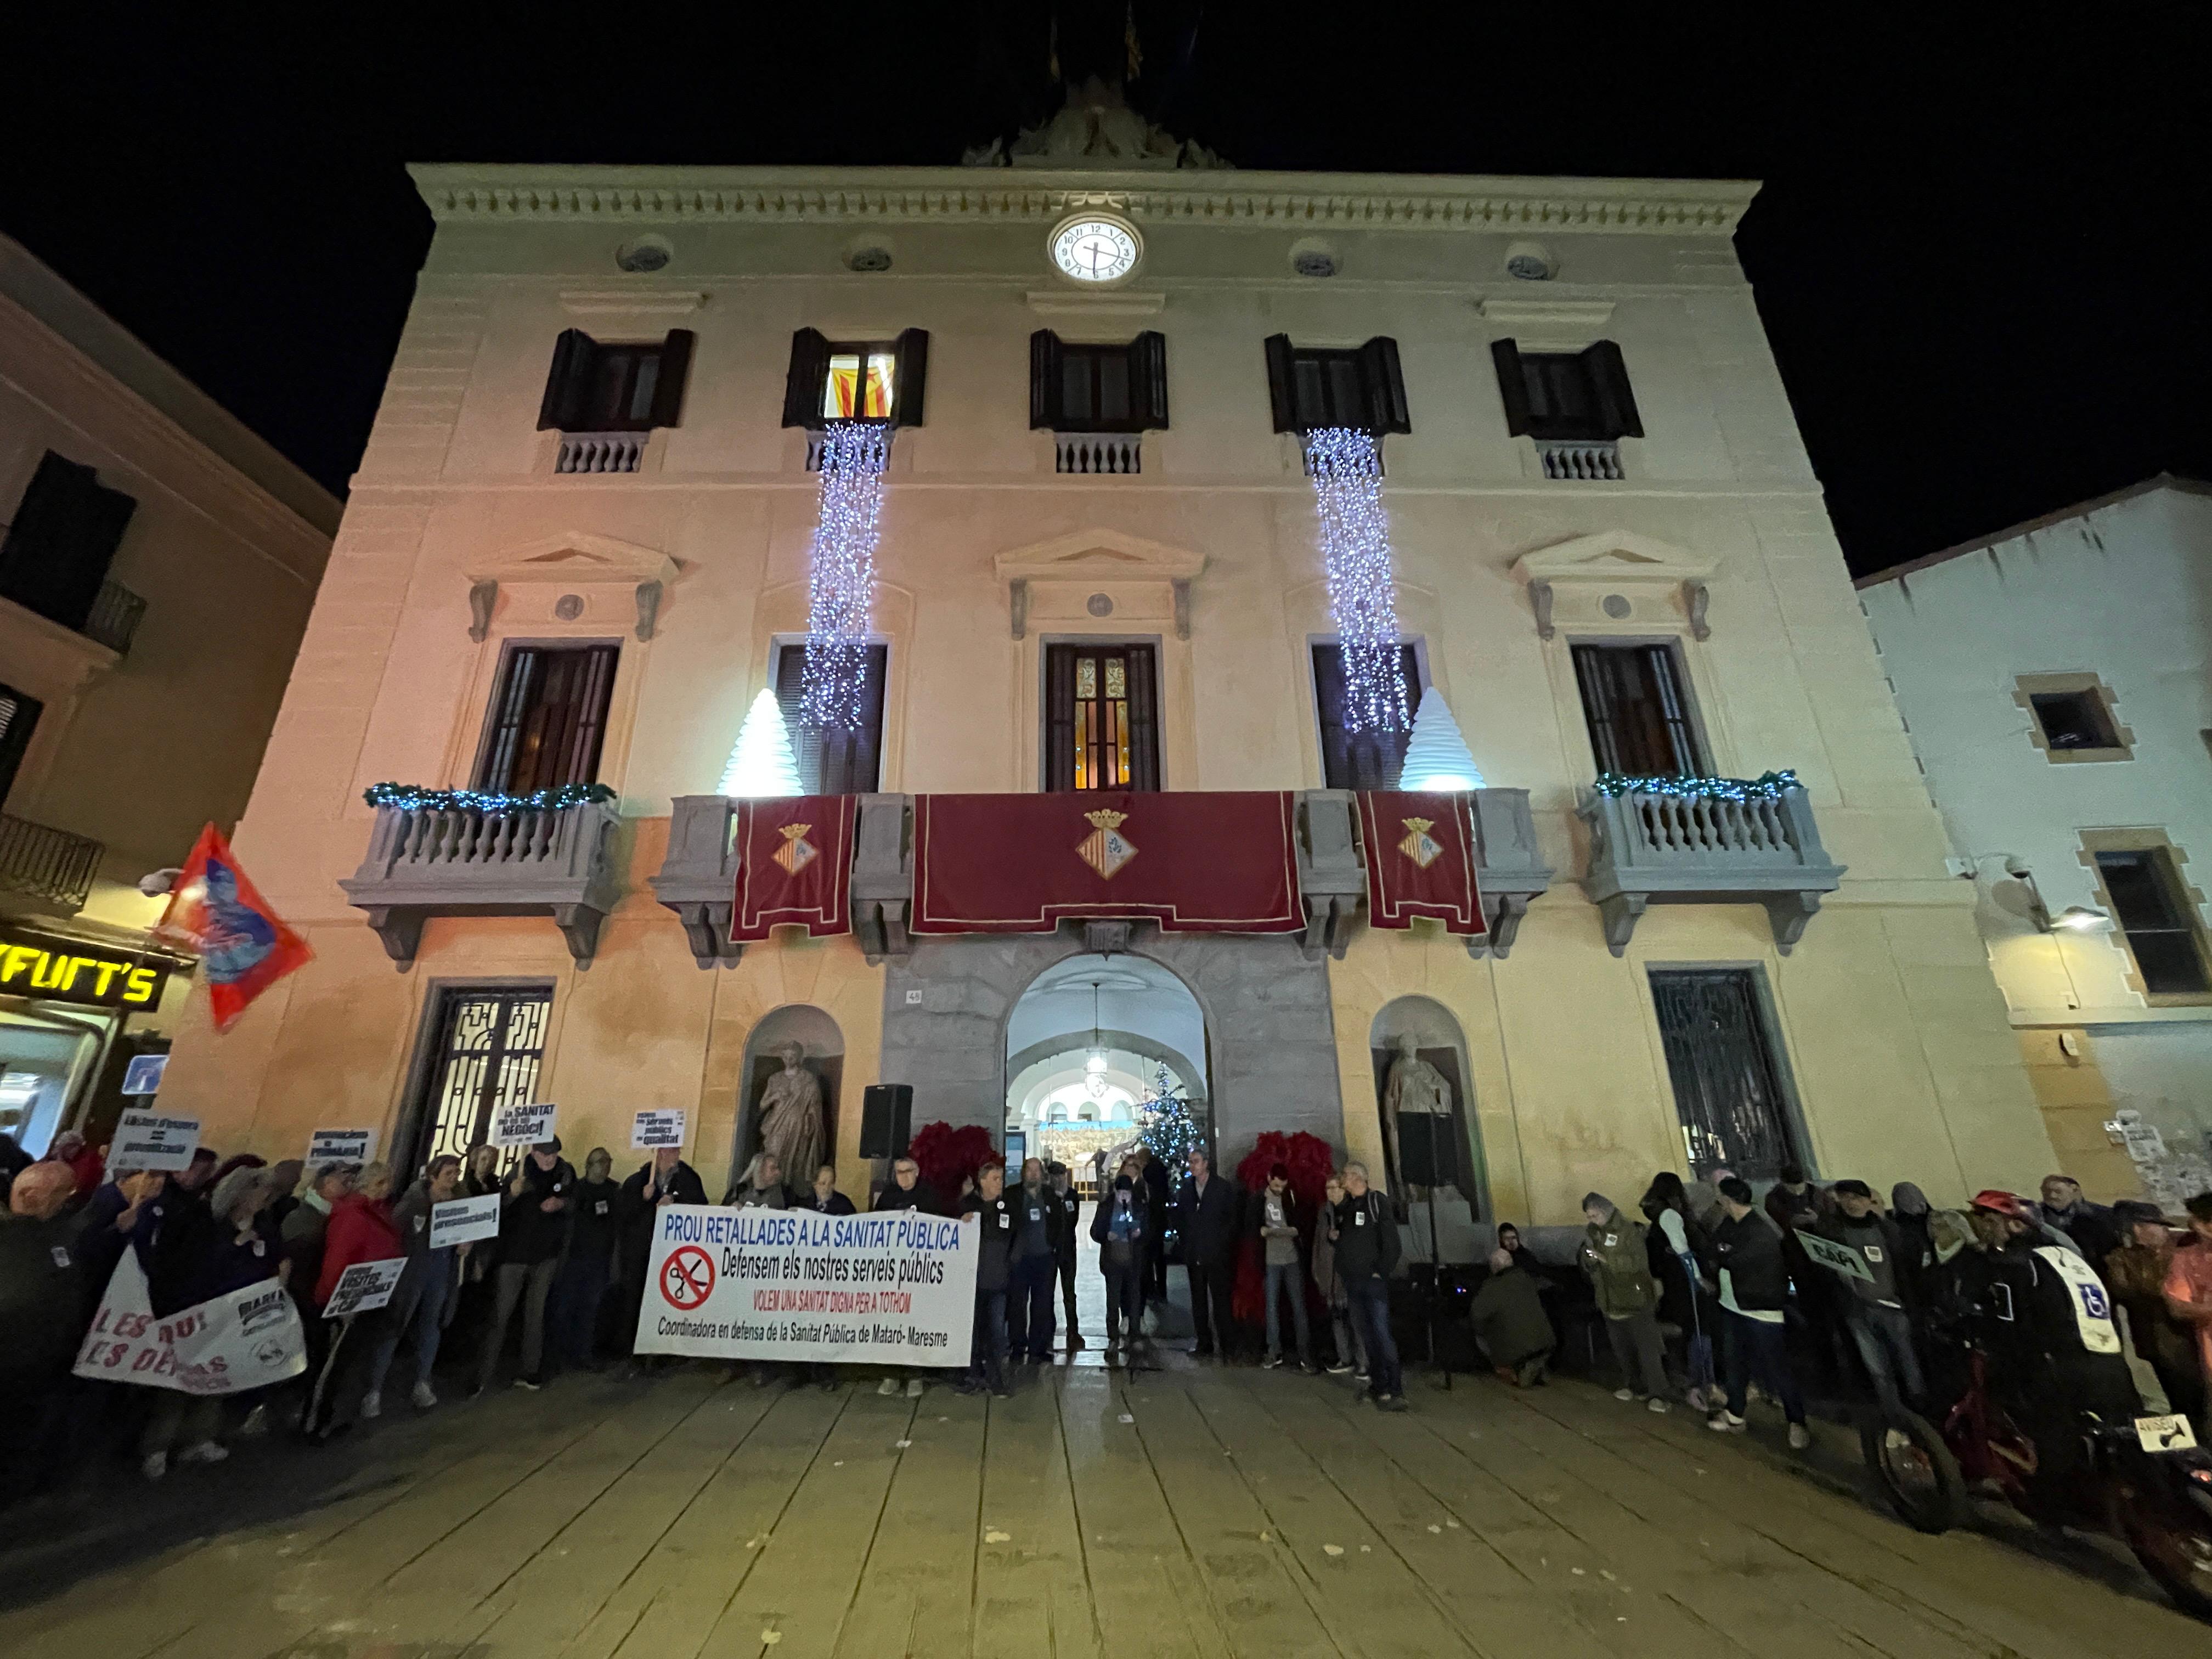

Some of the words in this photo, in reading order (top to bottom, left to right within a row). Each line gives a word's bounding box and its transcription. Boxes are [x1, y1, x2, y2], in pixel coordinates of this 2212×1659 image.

[1064, 235, 1073, 244] 10
[1076, 267, 1081, 275] 7
[1109, 268, 1114, 276] 5
[515, 1104, 555, 1117] SANITAT
[501, 1120, 544, 1136] NEGOCI!
[665, 1214, 702, 1242] PROU
[706, 1217, 795, 1245] RETALLADES
[798, 1219, 808, 1246] A
[812, 1220, 830, 1247] LA
[834, 1221, 895, 1248] SANITAT
[896, 1215, 959, 1250] PÚBLICA
[721, 1247, 780, 1279] Defensem
[783, 1249, 800, 1279] els
[804, 1251, 848, 1281] nostres
[852, 1251, 895, 1282] serveis
[898, 1251, 943, 1290] públics
[754, 1290, 780, 1311] VOLEM
[781, 1290, 795, 1311] UNA
[798, 1290, 830, 1312] SANITAT
[830, 1291, 853, 1313] DIGNA
[855, 1292, 870, 1314] PER
[871, 1293, 876, 1313] A
[879, 1291, 911, 1313] TOTHOM
[658, 1316, 715, 1338] Coordinadora
[719, 1323, 729, 1338] en
[731, 1321, 764, 1340] defensa
[767, 1322, 777, 1341] de
[780, 1322, 788, 1341] la
[791, 1322, 822, 1342] Sanitat
[823, 1323, 856, 1343] Pública
[858, 1324, 870, 1342] de
[907, 1326, 948, 1347] Maresme
